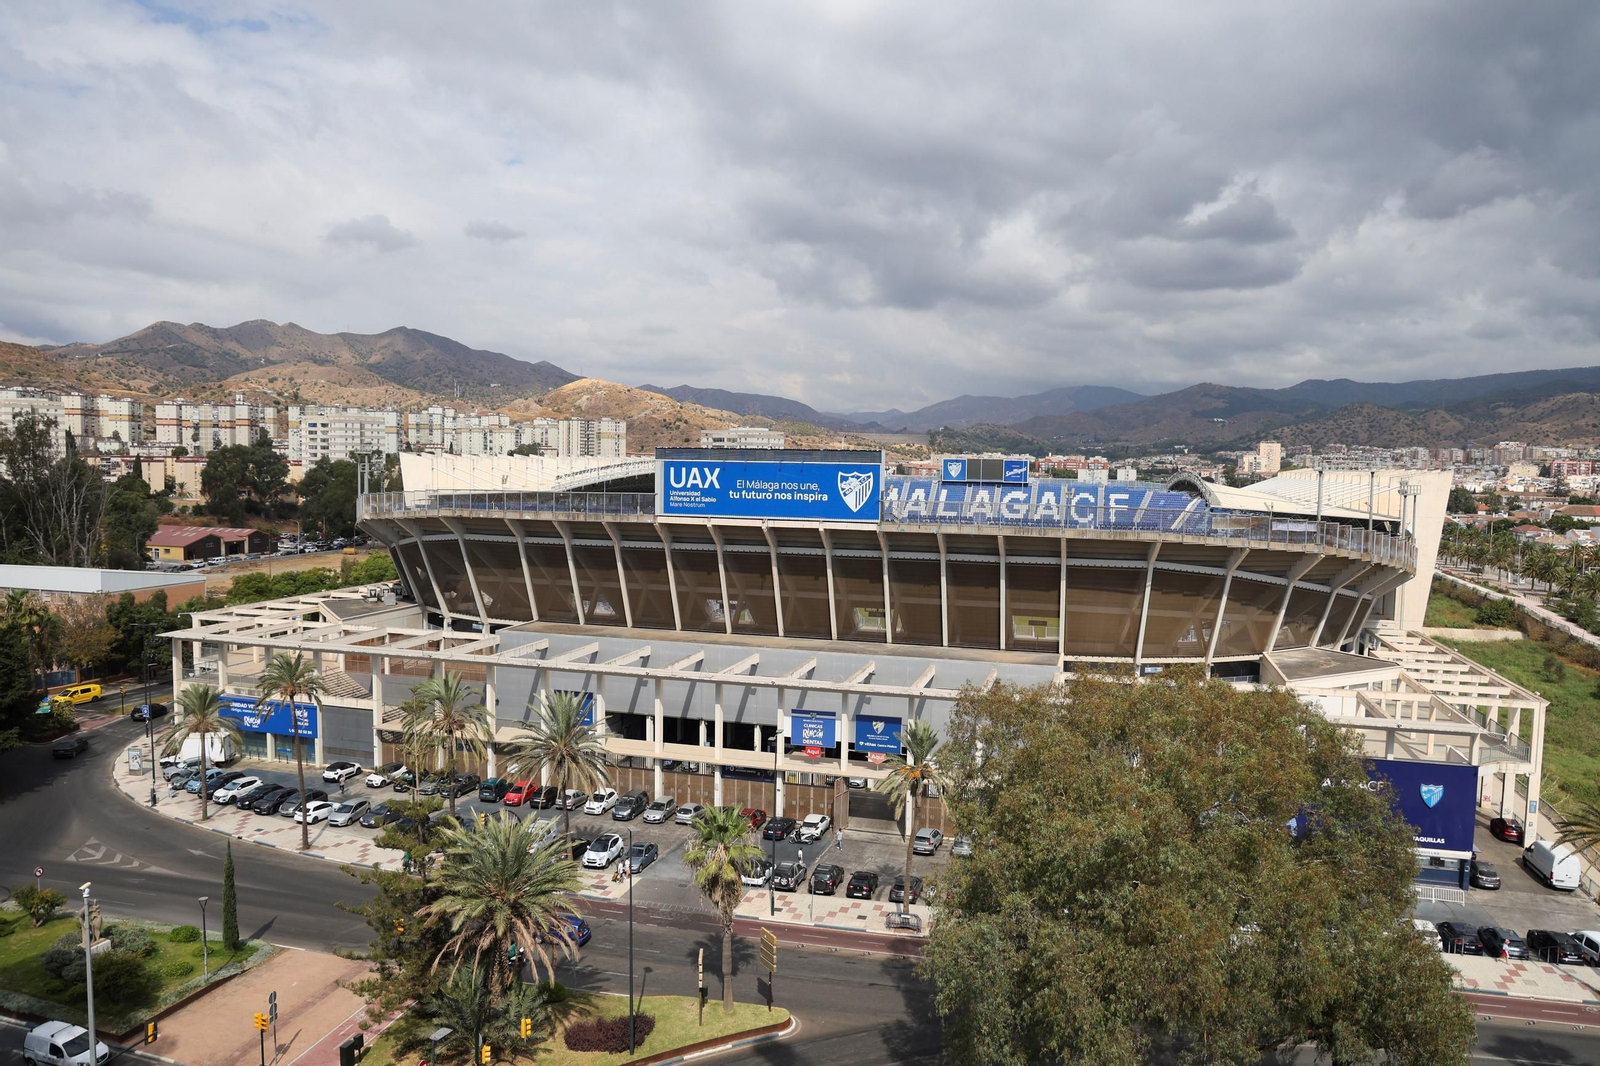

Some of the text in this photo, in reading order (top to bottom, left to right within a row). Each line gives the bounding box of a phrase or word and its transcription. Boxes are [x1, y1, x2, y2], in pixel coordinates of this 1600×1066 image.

[670, 466, 720, 489] UAX
[736, 479, 820, 492] El Málaga nos une,
[729, 490, 828, 503] tu futuro nos inspira
